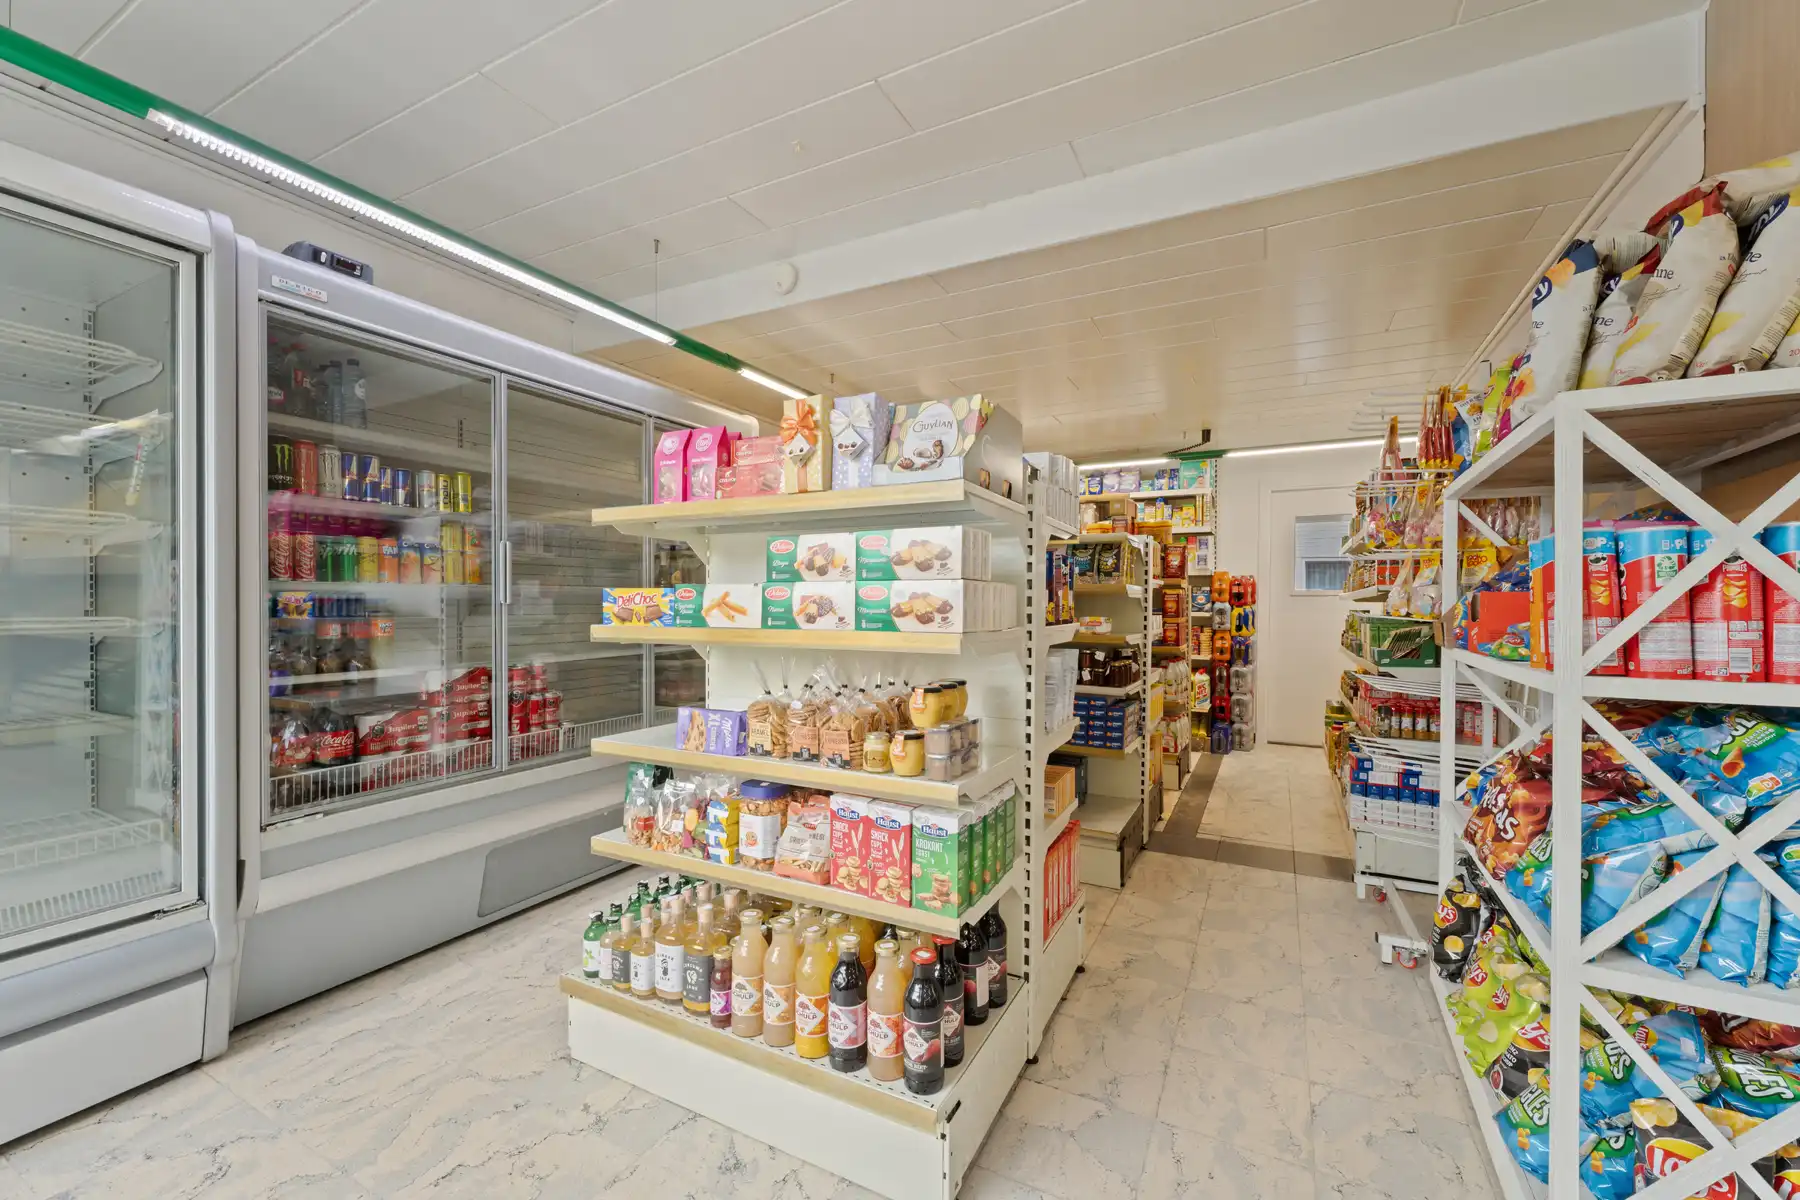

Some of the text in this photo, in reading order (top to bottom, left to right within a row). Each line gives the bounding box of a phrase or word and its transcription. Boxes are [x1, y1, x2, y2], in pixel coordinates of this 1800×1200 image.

[838, 808, 859, 820] Haust
[876, 817, 901, 829] Haust
[922, 827, 949, 838] Haust
[915, 838, 944, 853] KROKANT
